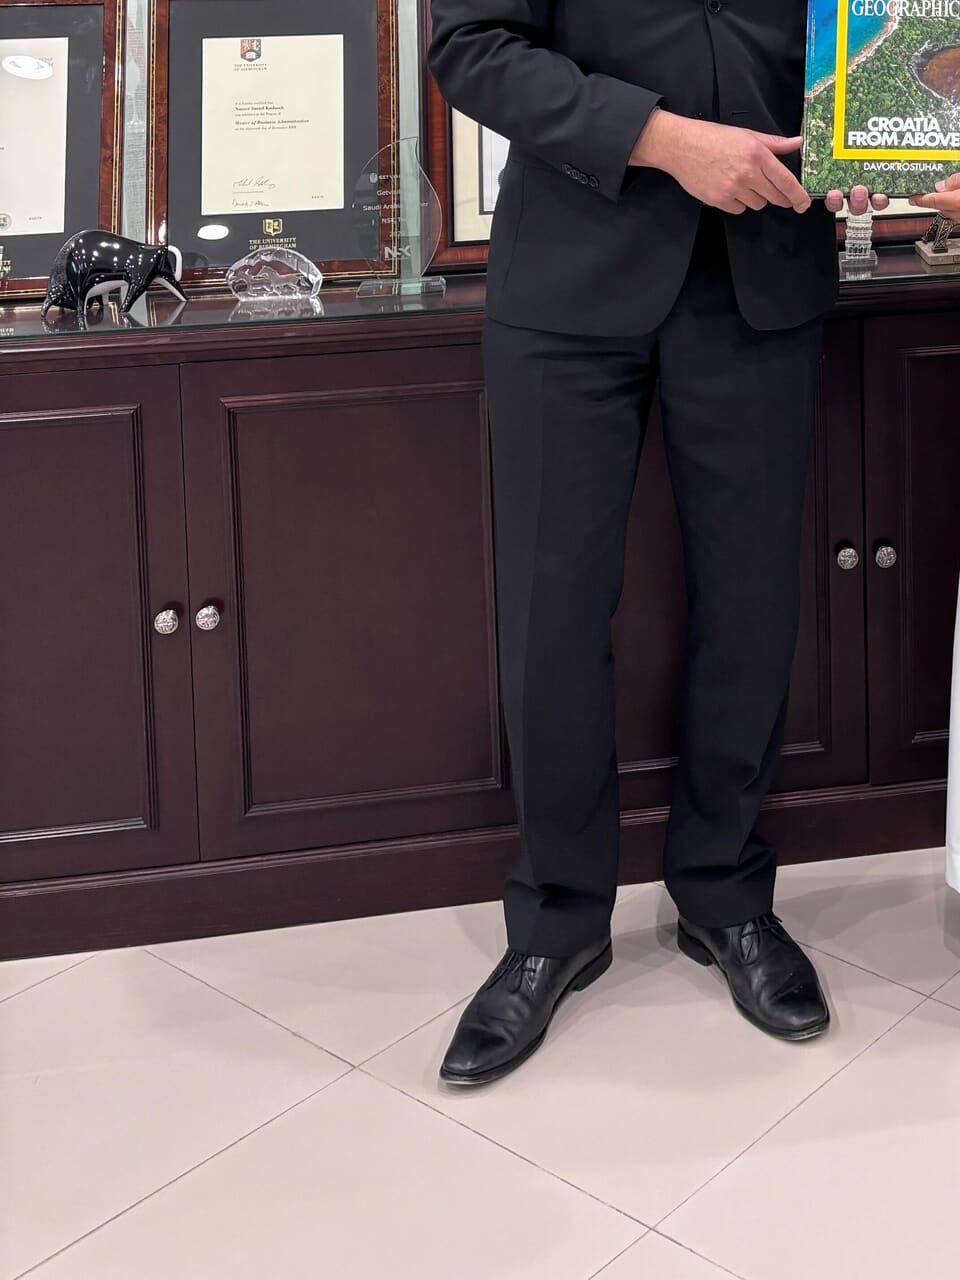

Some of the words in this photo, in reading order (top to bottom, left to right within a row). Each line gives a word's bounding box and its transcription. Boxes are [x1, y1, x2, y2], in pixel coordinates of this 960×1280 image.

[867, 116, 940, 132] CROATIA
[847, 131, 899, 147] FROM
[901, 131, 960, 148] ABOVE
[863, 162, 896, 171] DAVOR
[896, 162, 943, 172] ROSTUHAR
